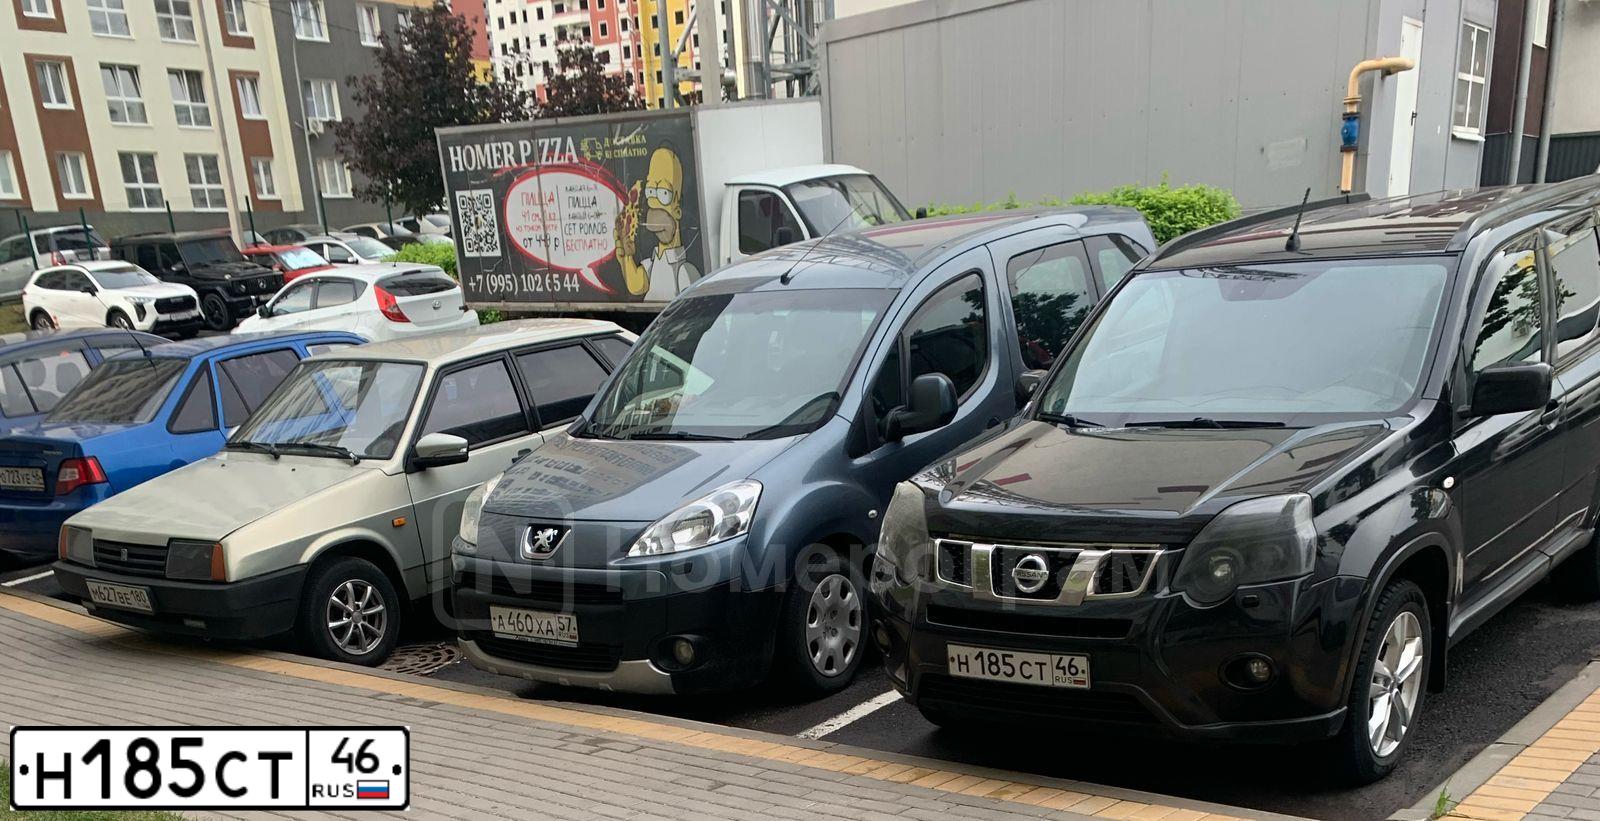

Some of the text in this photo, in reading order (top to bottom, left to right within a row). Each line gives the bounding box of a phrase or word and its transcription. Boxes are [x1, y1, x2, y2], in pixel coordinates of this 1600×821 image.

[448, 141, 518, 172] HOMER
[567, 195, 597, 208] ПИЦЦА
[564, 222, 608, 236] СЕТ РОЛЛОВ
[565, 238, 608, 252] БЕСПЛАТНО
[469, 274, 483, 293] +7
[486, 273, 519, 295] (995)
[521, 273, 544, 292] 102
[563, 273, 580, 293] 44
[498, 611, 571, 636] А460ХА 57
[957, 651, 1079, 681] Н185СТ 46
[1055, 676, 1073, 684] RUS
